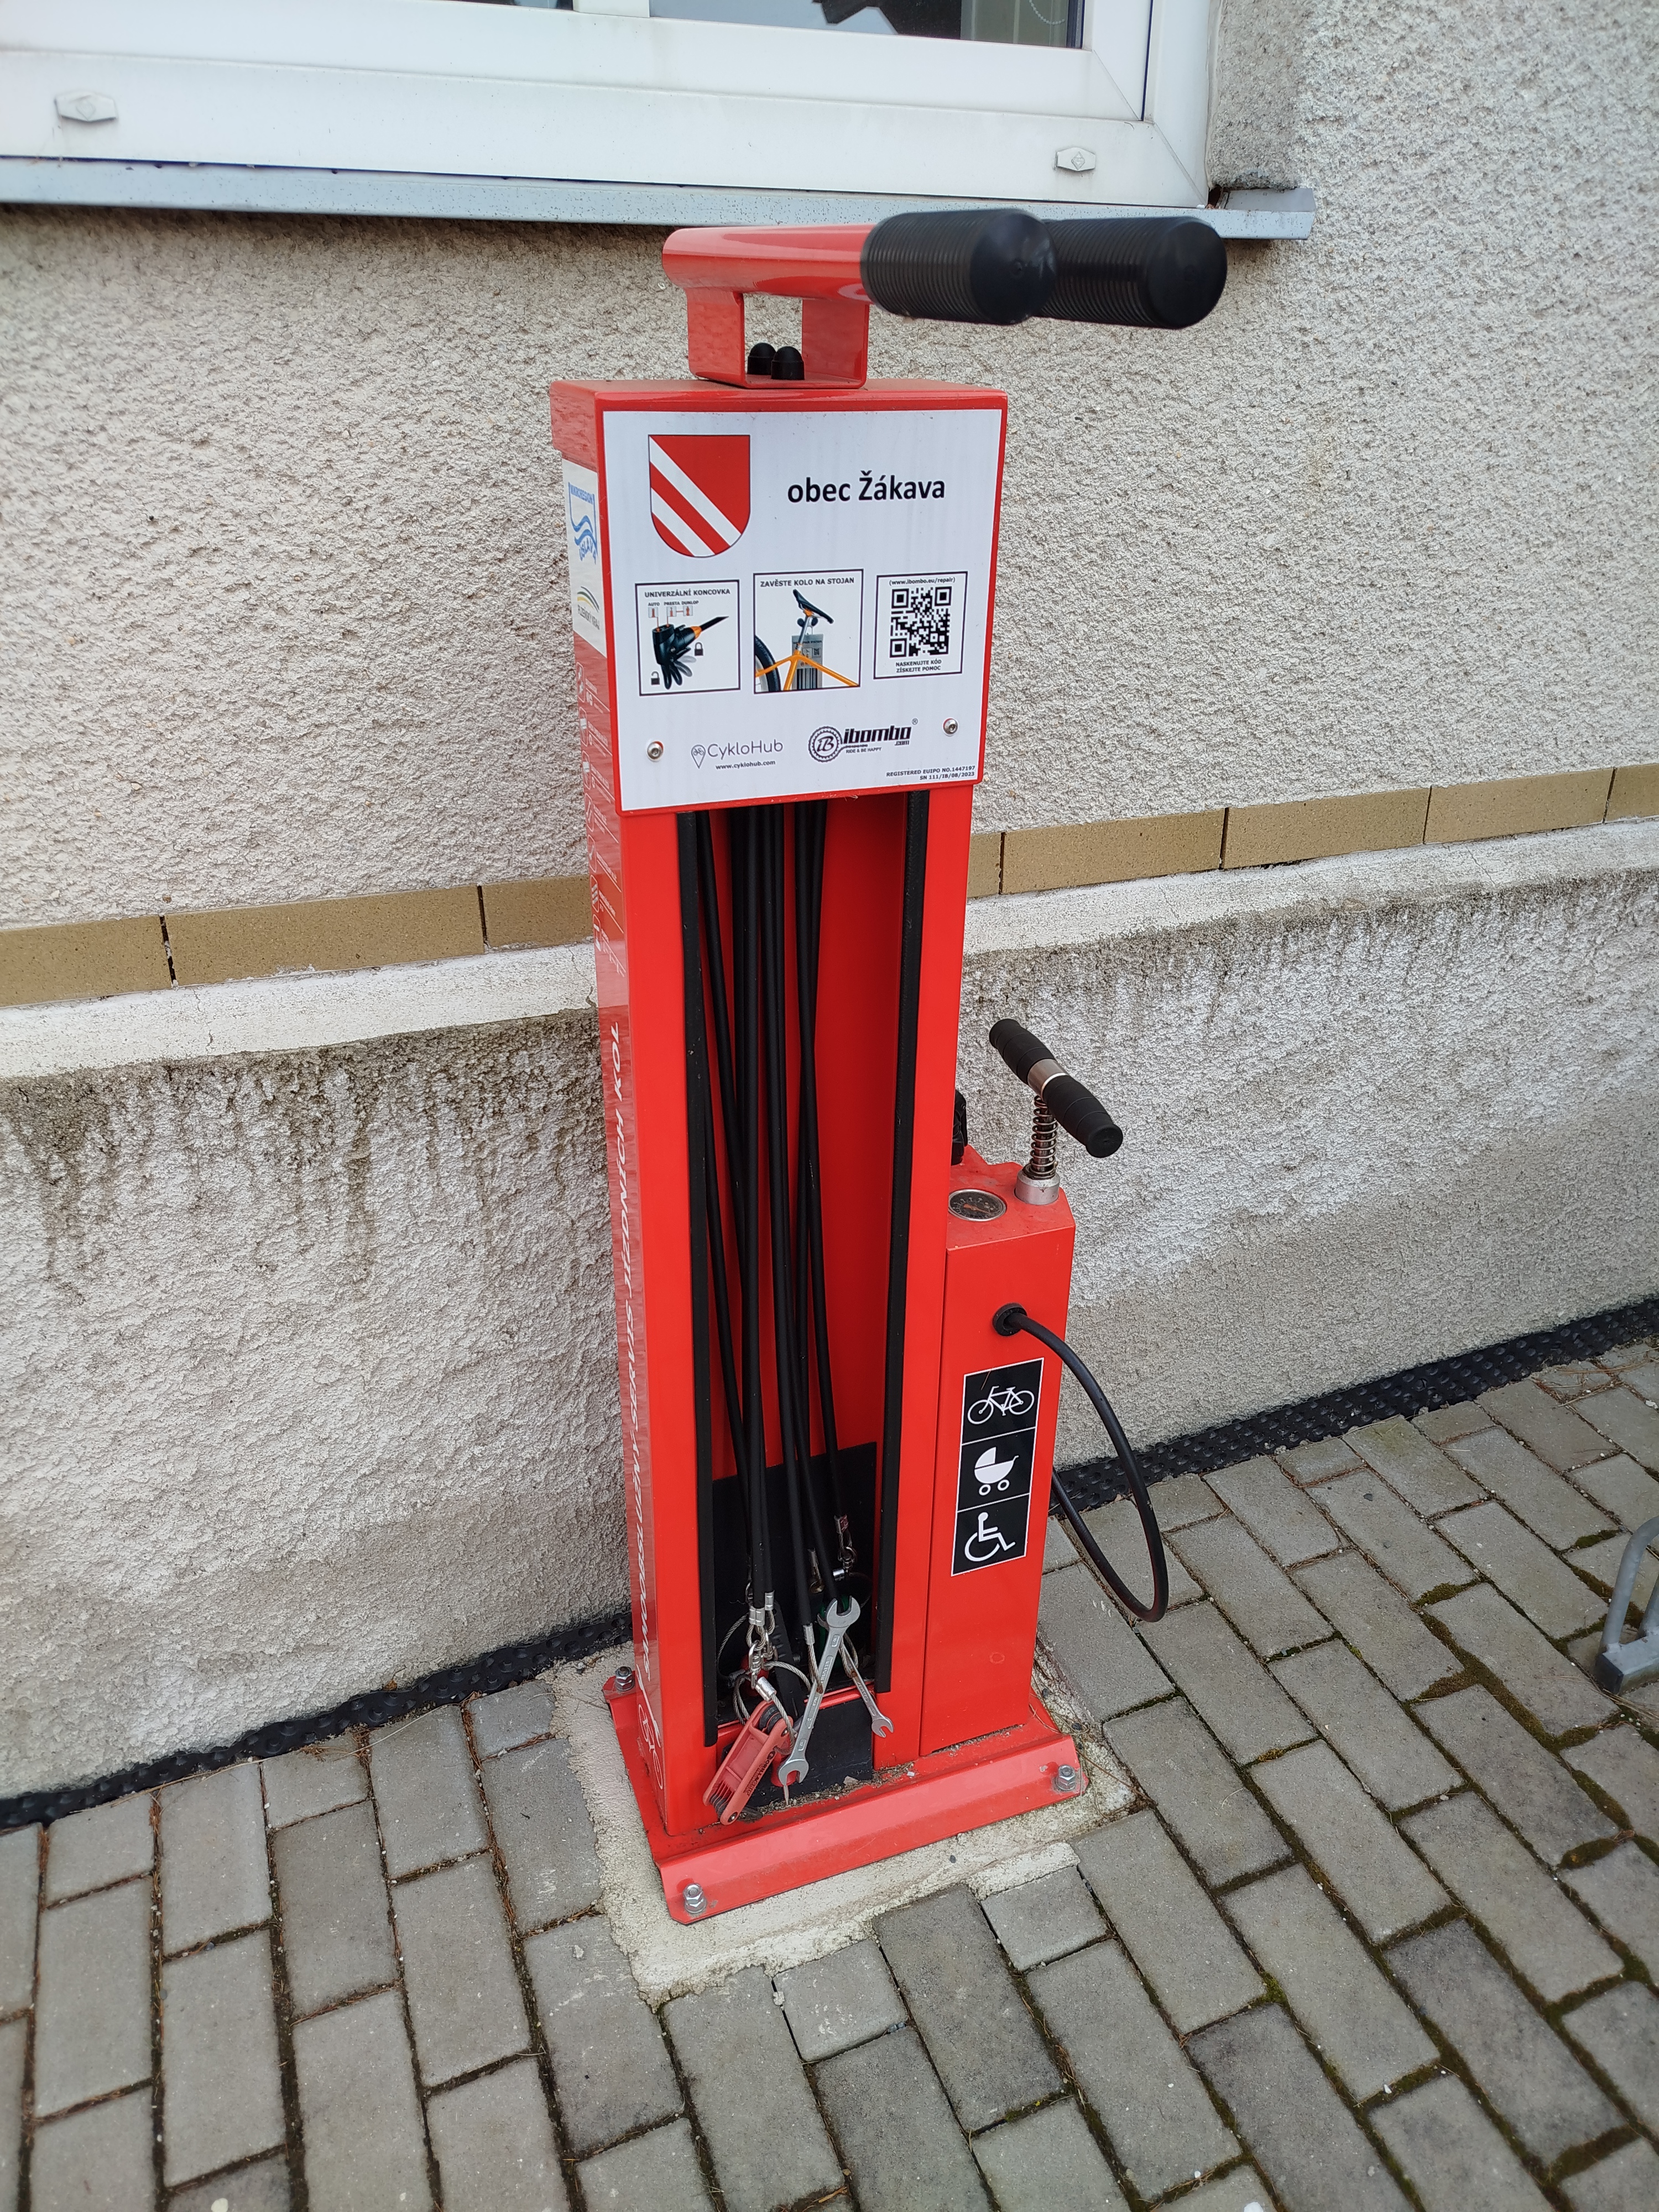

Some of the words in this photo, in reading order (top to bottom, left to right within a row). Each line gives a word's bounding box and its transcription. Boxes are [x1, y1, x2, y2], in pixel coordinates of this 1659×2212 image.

[788, 477, 850, 503] obec
[859, 471, 945, 500] Žákava
[645, 588, 691, 597] UNIVERZÁLNÍ
[708, 739, 782, 760] CykloHub
[843, 726, 911, 744] ibombo
[716, 760, 775, 769] www.cyklohub.com
[611, 1021, 623, 1102] KOL
[615, 1108, 632, 1298] JÍZDNÍCH
[625, 1299, 638, 1431] SERVIS
[630, 1431, 650, 1682] SAMOOBSLUŽNÝ
